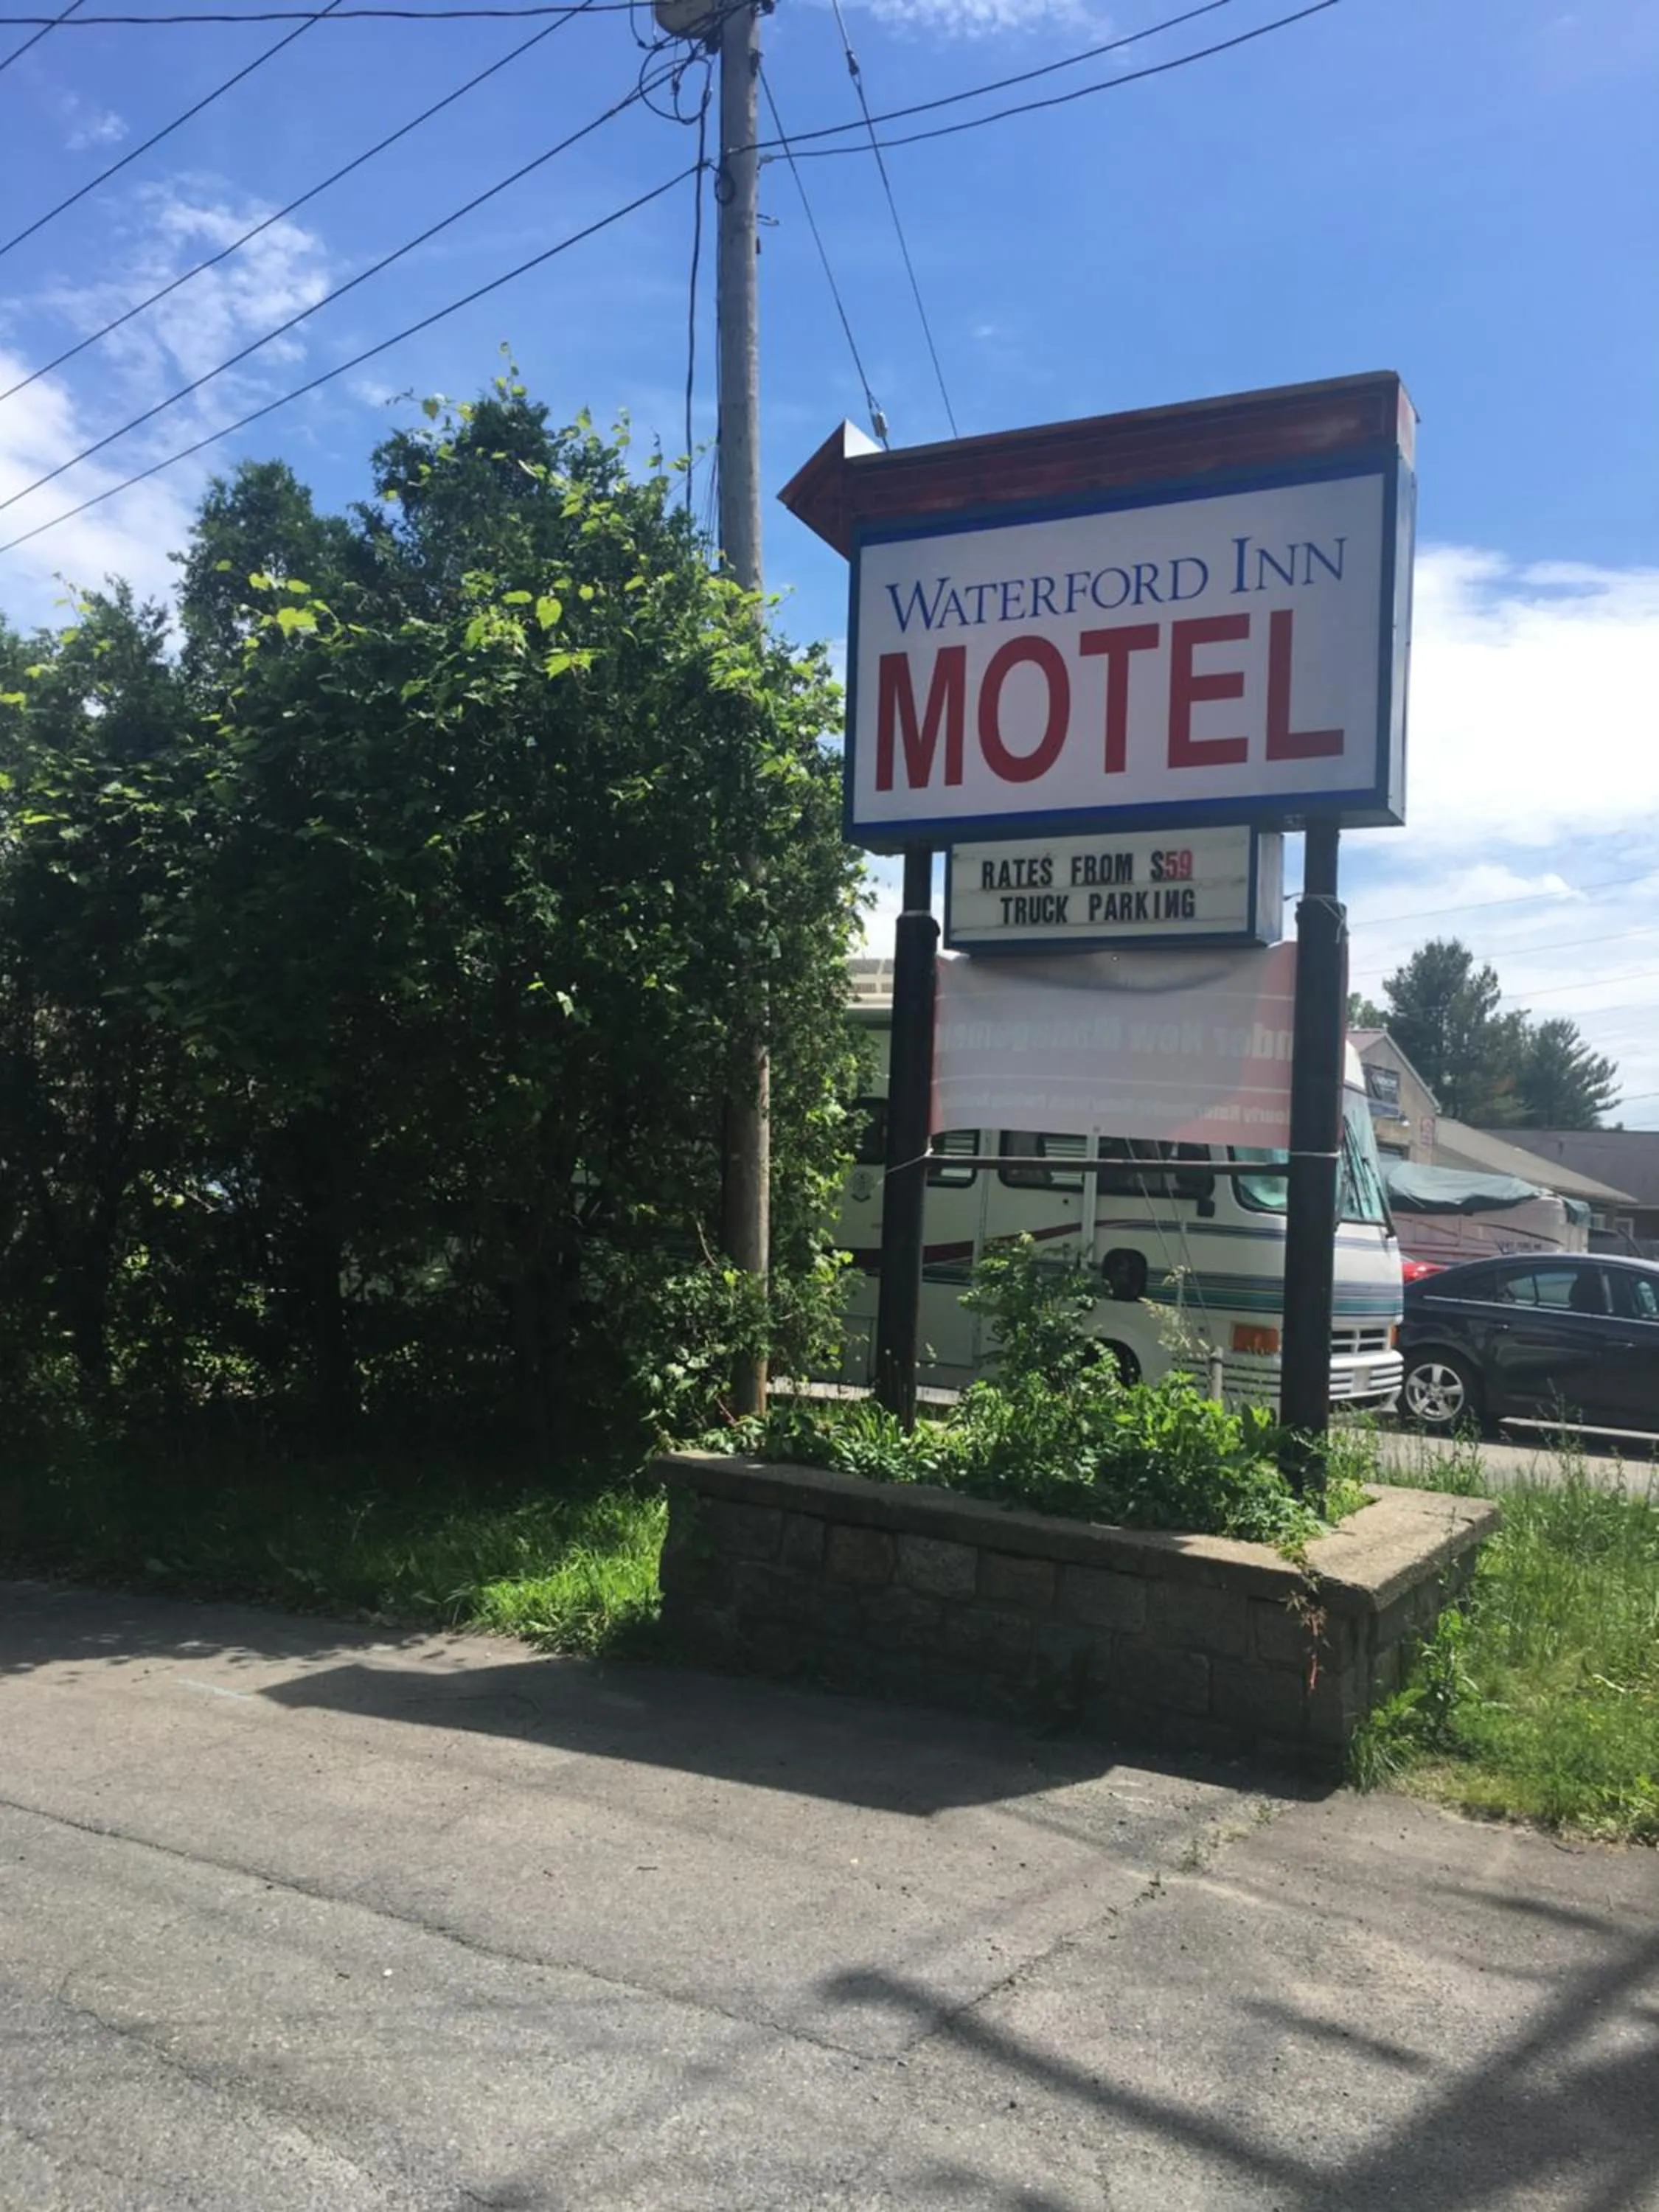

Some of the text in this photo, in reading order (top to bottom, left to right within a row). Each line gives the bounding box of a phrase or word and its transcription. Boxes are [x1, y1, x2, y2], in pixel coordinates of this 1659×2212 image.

[885, 537, 1348, 633] WATERFORD INN
[875, 608, 1346, 792] MOTEL
[981, 856, 1054, 889] RATES
[1071, 852, 1134, 886] FROM
[1000, 888, 1196, 925] TRUCK PARKING
